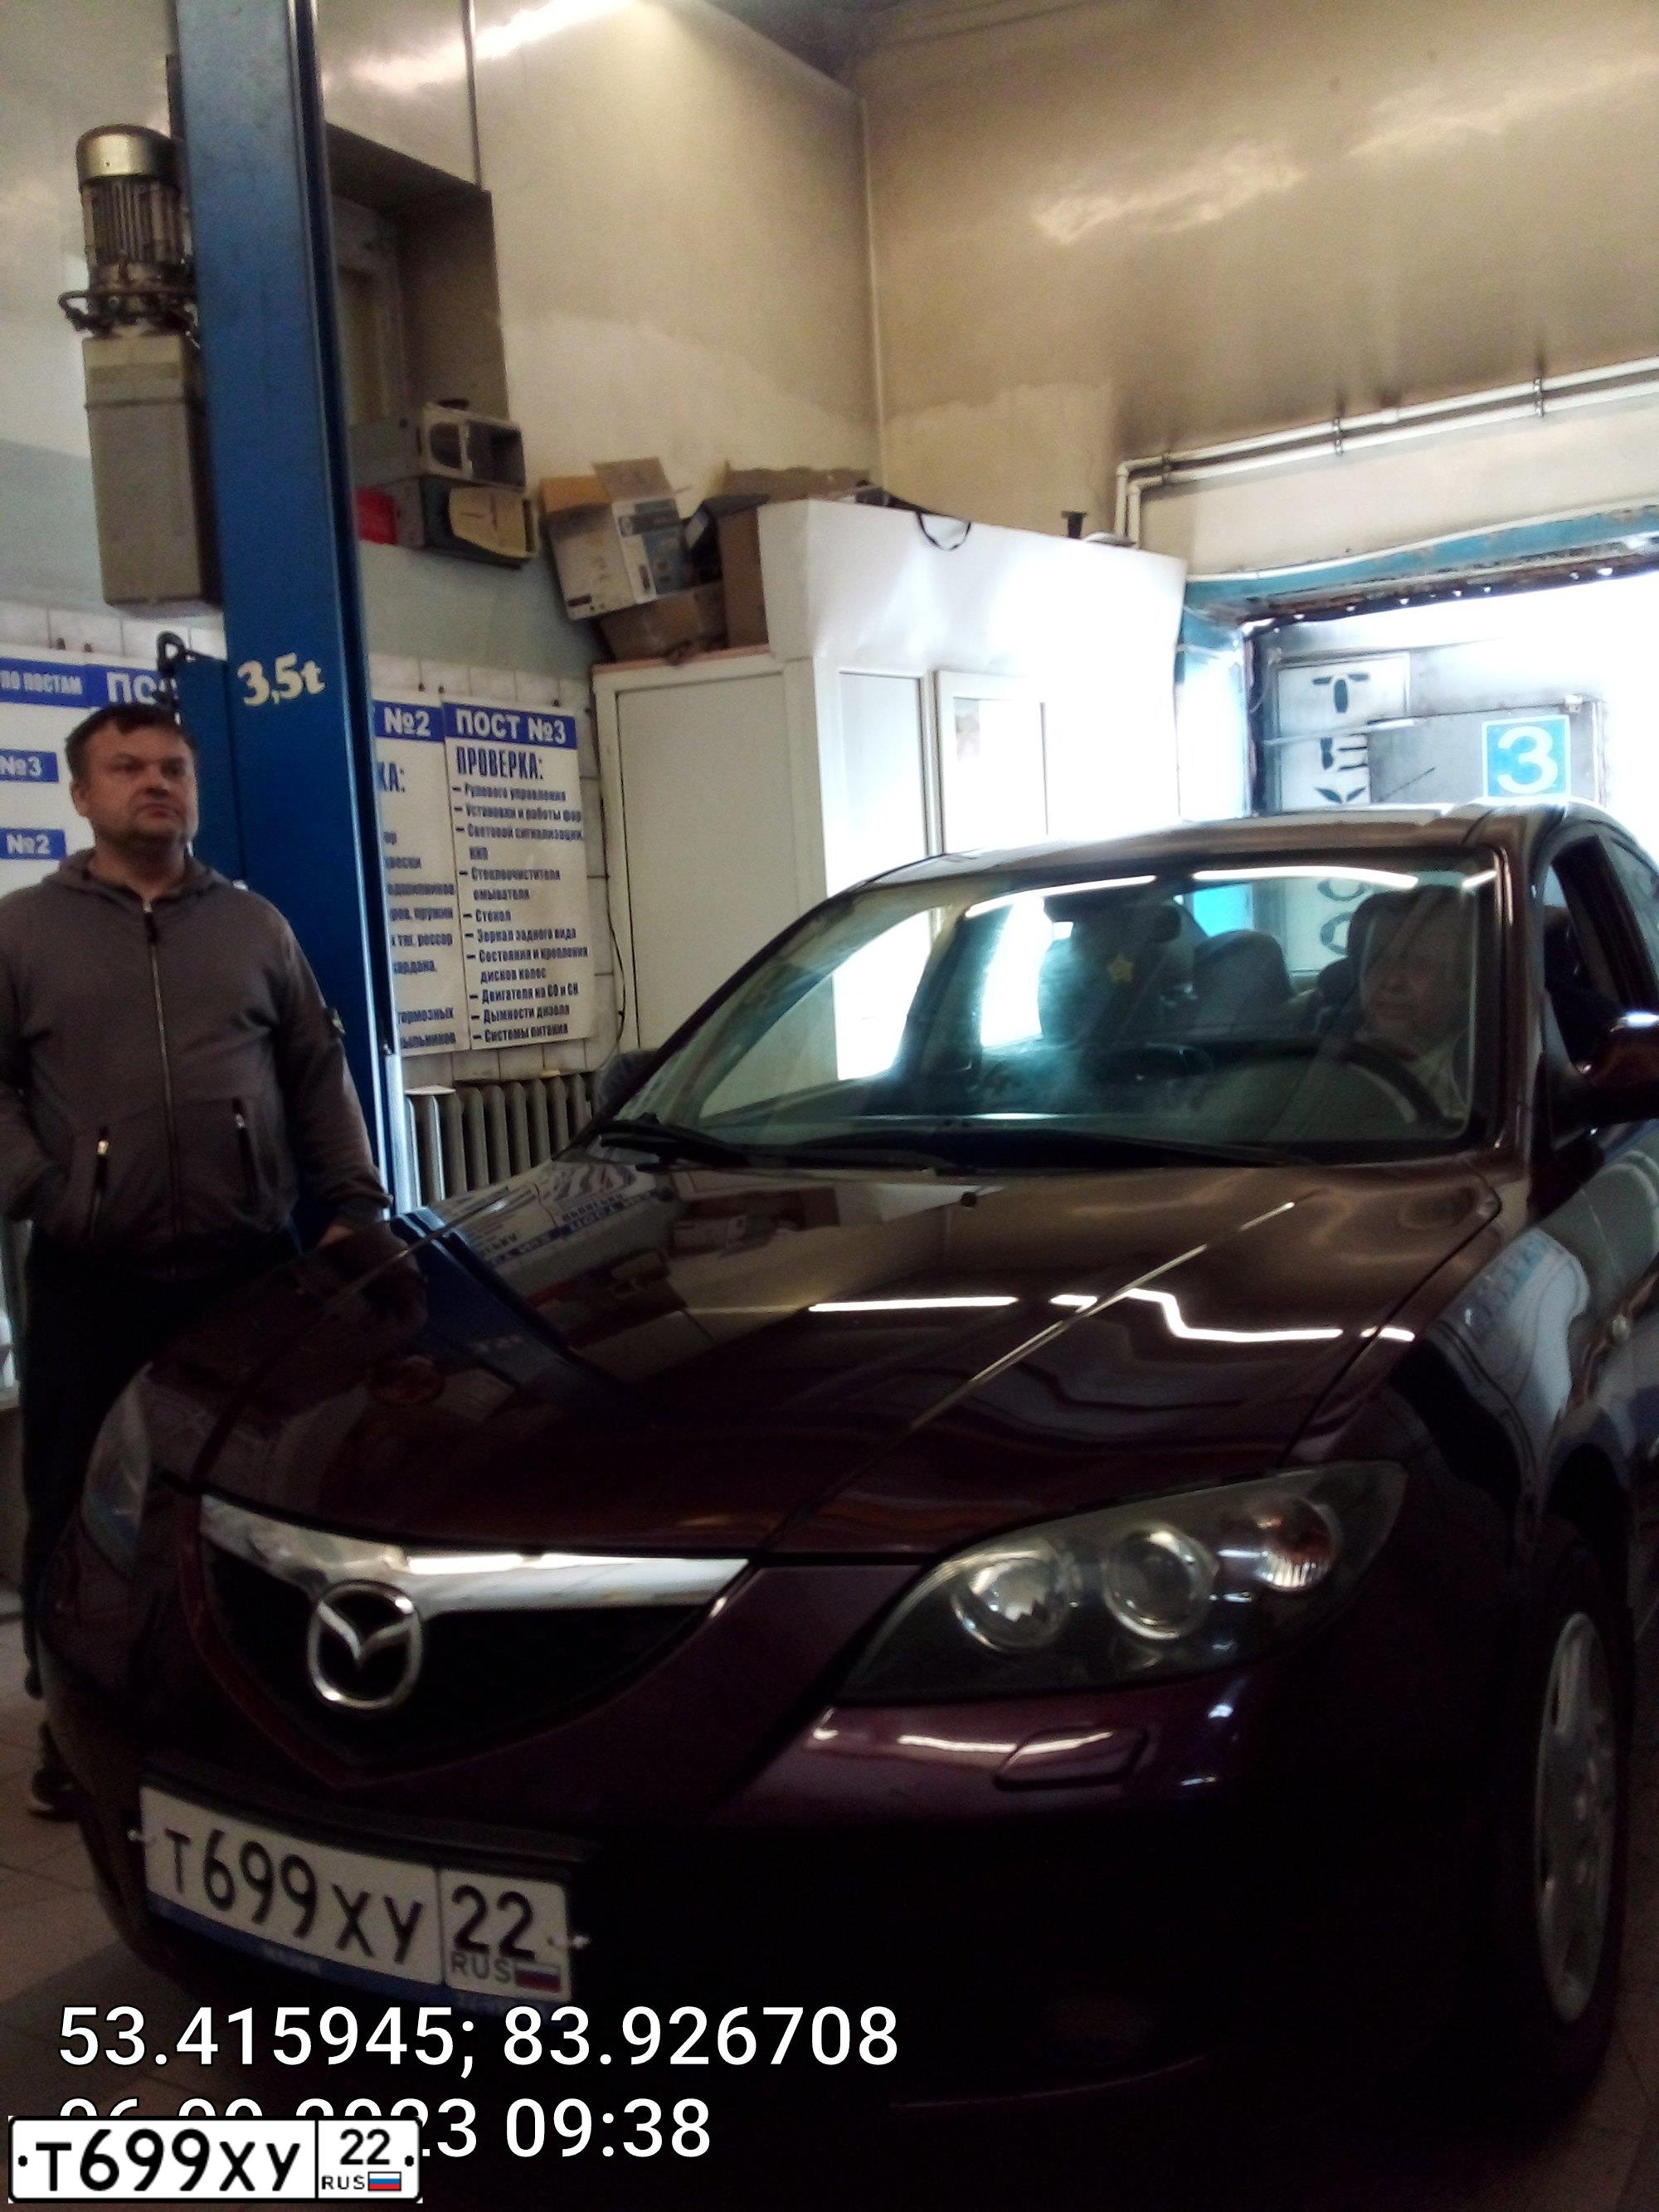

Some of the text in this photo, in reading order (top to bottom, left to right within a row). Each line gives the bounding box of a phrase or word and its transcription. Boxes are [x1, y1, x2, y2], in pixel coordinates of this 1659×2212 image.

[456, 709, 567, 745] ПОСТ №3
[456, 746, 543, 780] ПРОВЕРКА:
[1495, 725, 1559, 794] 3
[476, 909, 512, 922] Стекол
[477, 928, 577, 943] Зеркал заднего вида
[480, 967, 547, 984] дисков колес
[482, 987, 533, 1004] Двигателя
[484, 1004, 570, 1025] Дымности дизеля
[484, 1023, 568, 1043] Системы питания
[451, 1885, 536, 1961] 22
[450, 1951, 514, 1983] RUS
